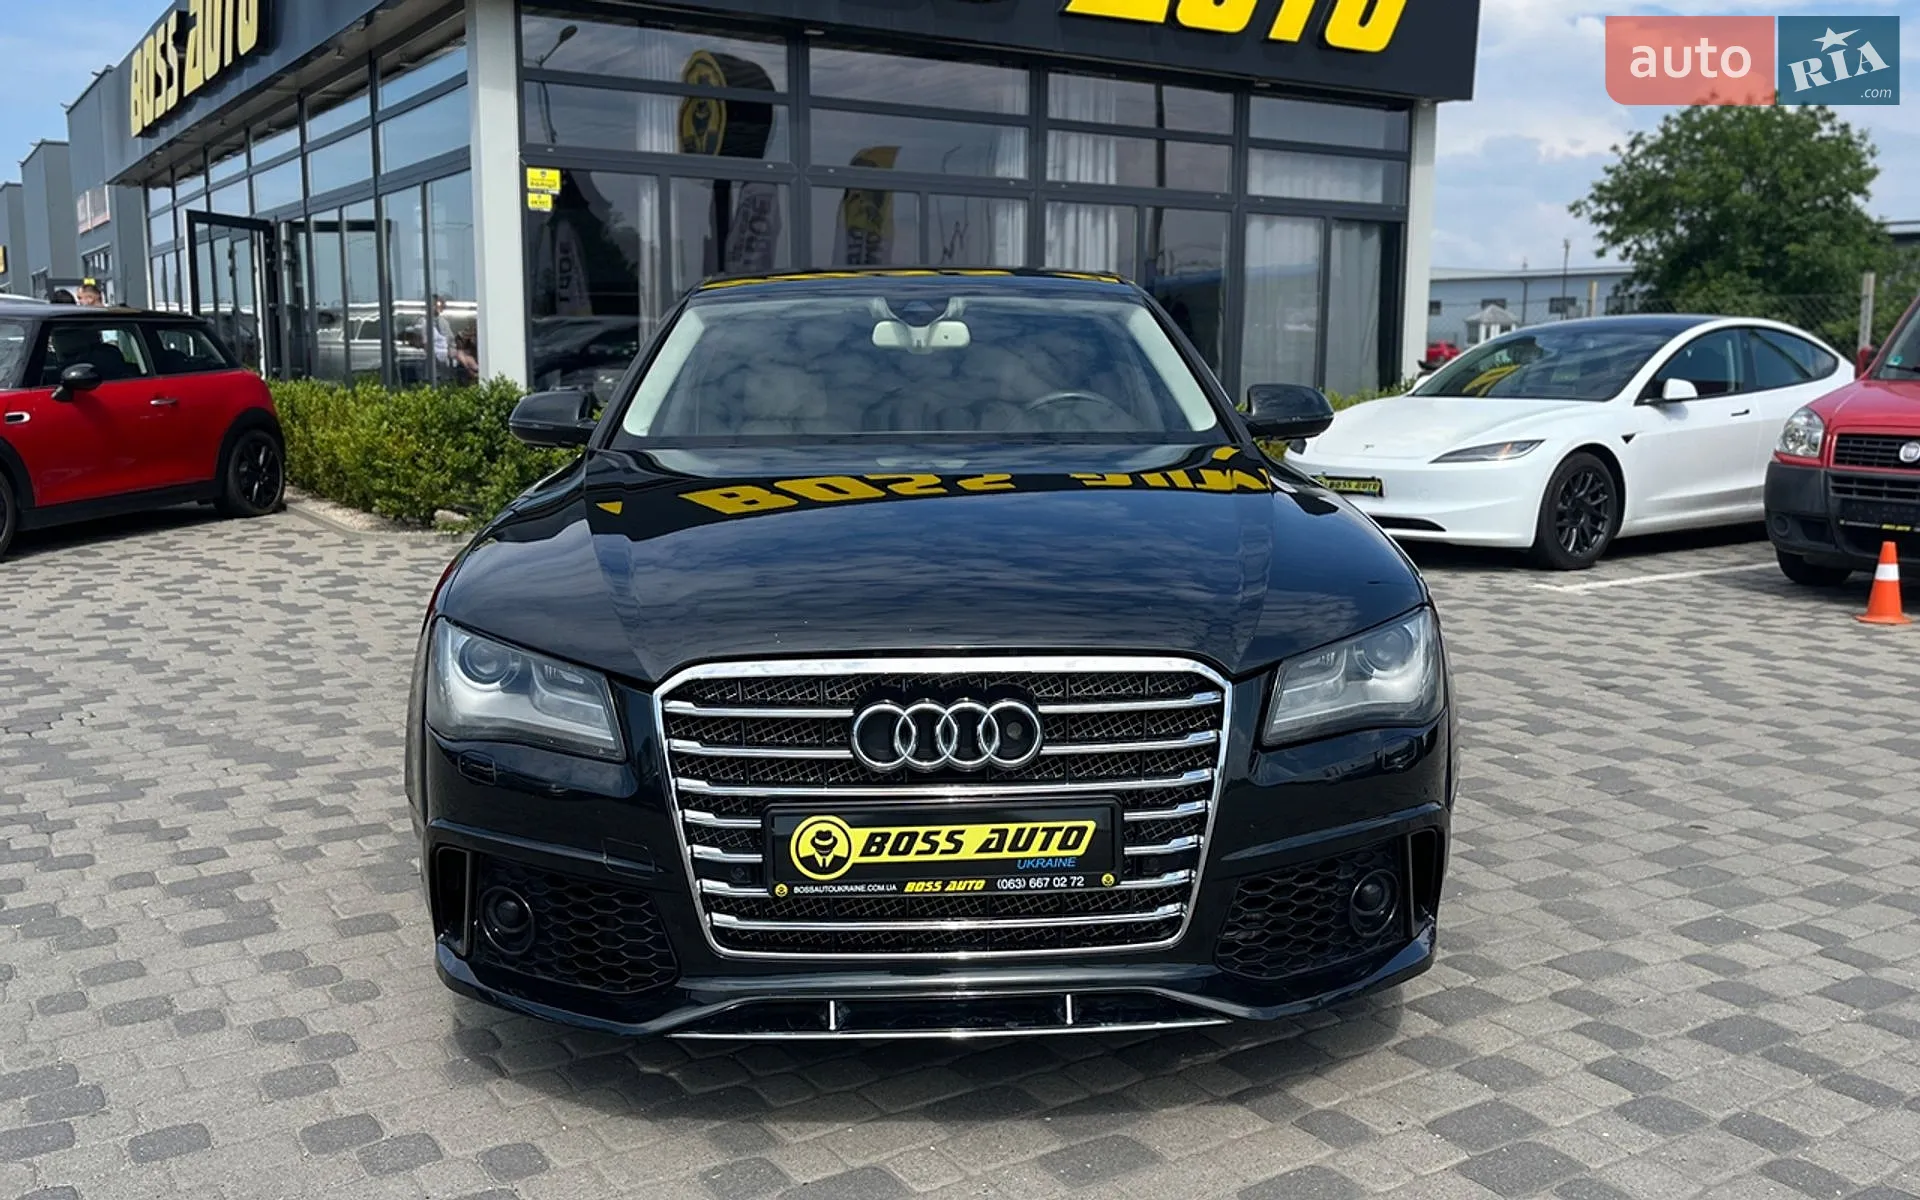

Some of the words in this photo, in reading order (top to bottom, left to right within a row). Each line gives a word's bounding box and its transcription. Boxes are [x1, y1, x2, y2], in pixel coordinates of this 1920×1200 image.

[130, 10, 178, 137] BOSS
[859, 829, 967, 858] BOSS
[975, 824, 1089, 852] AUTO
[1016, 857, 1077, 870] UKRAINE
[793, 883, 897, 894] BOSSAUTOUKRAINE.COM.UA
[903, 881, 943, 893] BOSS
[944, 880, 986, 892] AUTO
[996, 878, 1026, 890] (063)
[1029, 877, 1049, 888] 667
[1053, 876, 1067, 887] 02
[1070, 875, 1085, 886] 72
